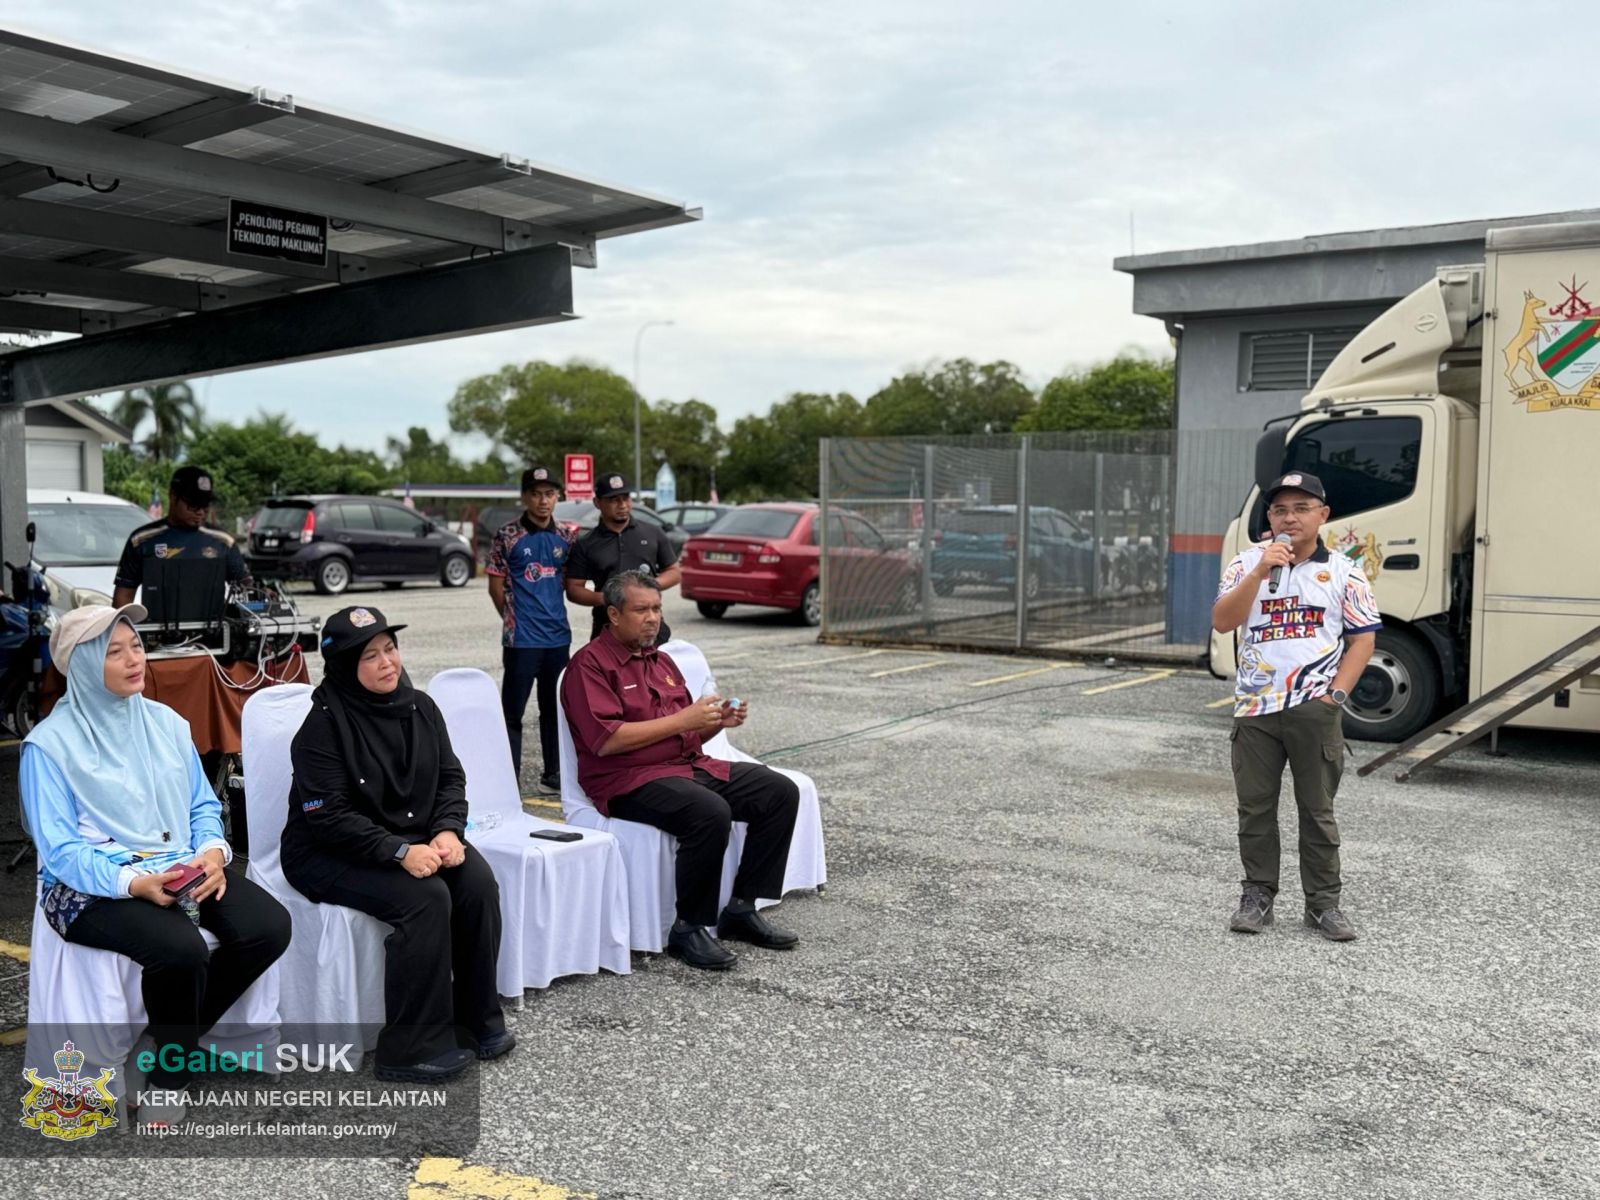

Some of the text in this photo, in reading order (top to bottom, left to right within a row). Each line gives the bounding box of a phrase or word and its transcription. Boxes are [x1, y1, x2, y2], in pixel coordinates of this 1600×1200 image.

[239, 213, 320, 237] PENOLONG PEGAWAI
[233, 229, 324, 255] TEKNOLOGI MAKLUMAT
[1518, 382, 1549, 398] MAJLIS
[1550, 397, 1591, 408] KUALA KRAI
[1264, 597, 1298, 613] HARI
[1272, 610, 1324, 625] SUKAN
[1253, 625, 1315, 642] NEGARA
